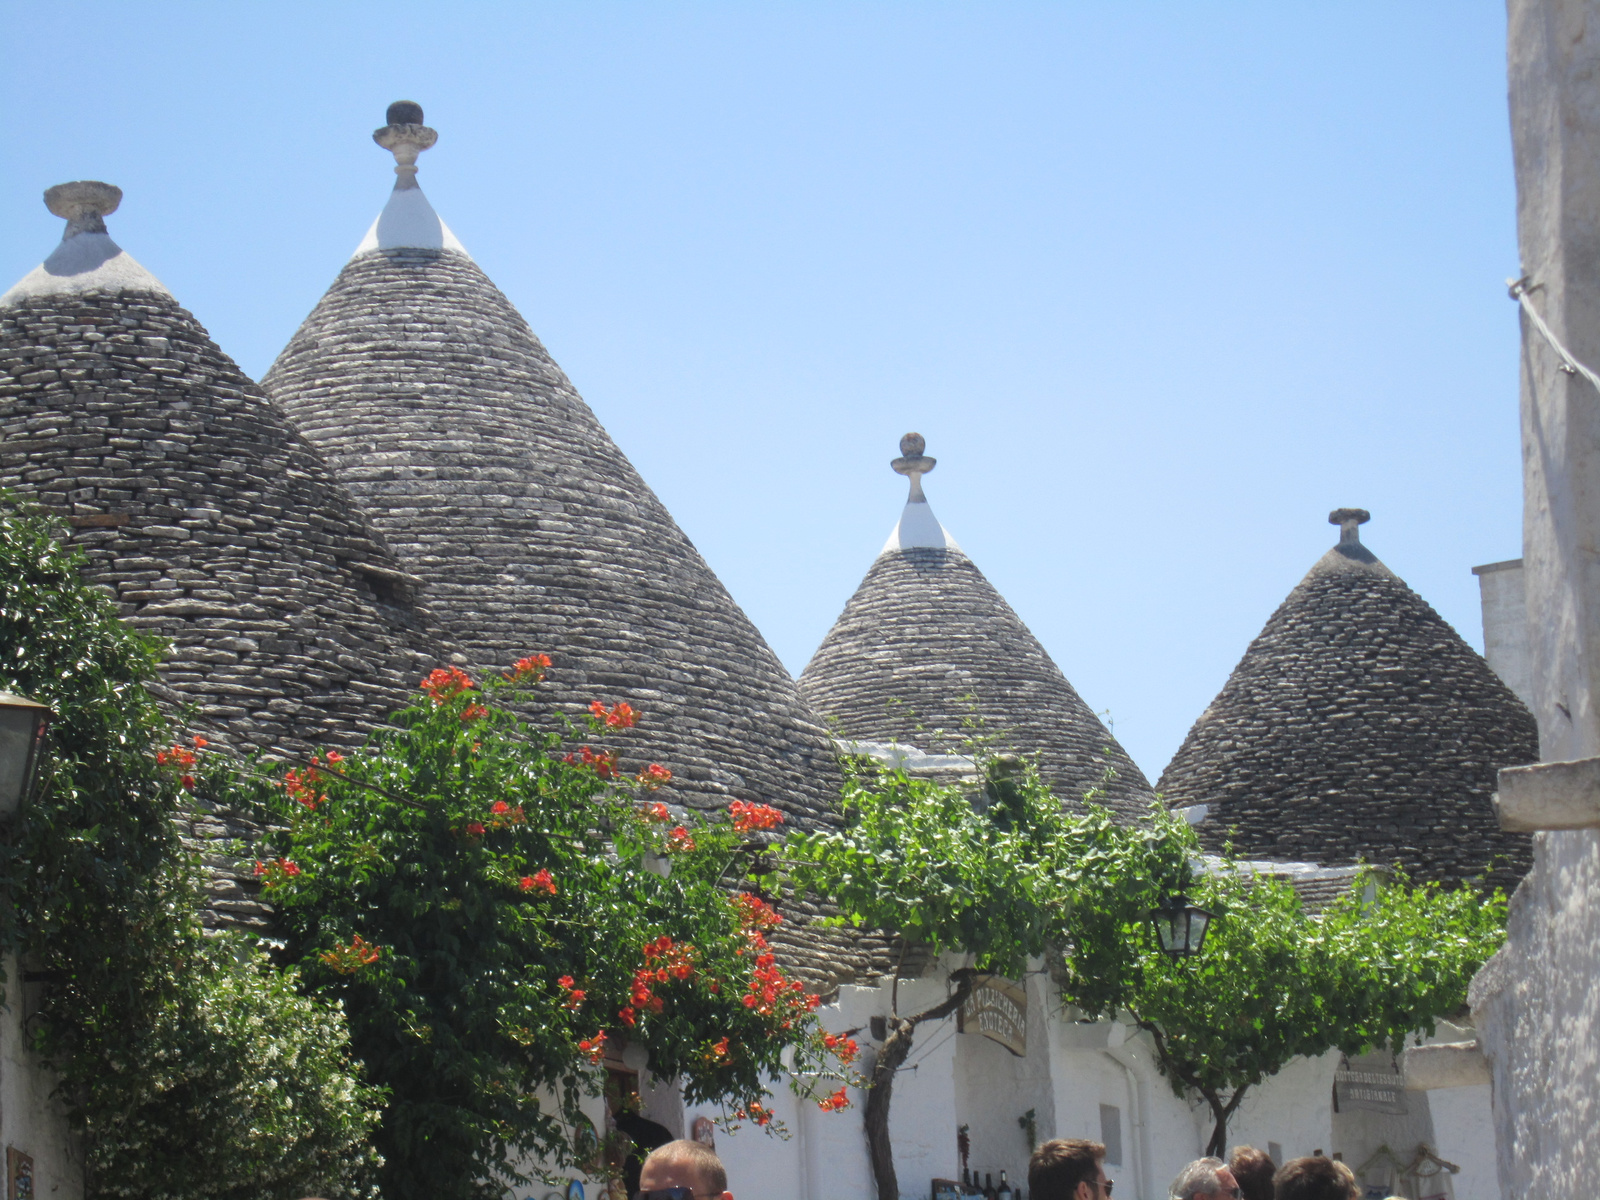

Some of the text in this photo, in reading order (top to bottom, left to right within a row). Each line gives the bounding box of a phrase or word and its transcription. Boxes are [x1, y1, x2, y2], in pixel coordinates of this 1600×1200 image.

[964, 987, 1025, 1037] LA PIZZICHERIA
[978, 1011, 1013, 1042] ENOTECA
[1335, 1070, 1404, 1087] BOTTEGA DEL TESSUTO
[1350, 1088, 1396, 1102] ARTIGIANALE
